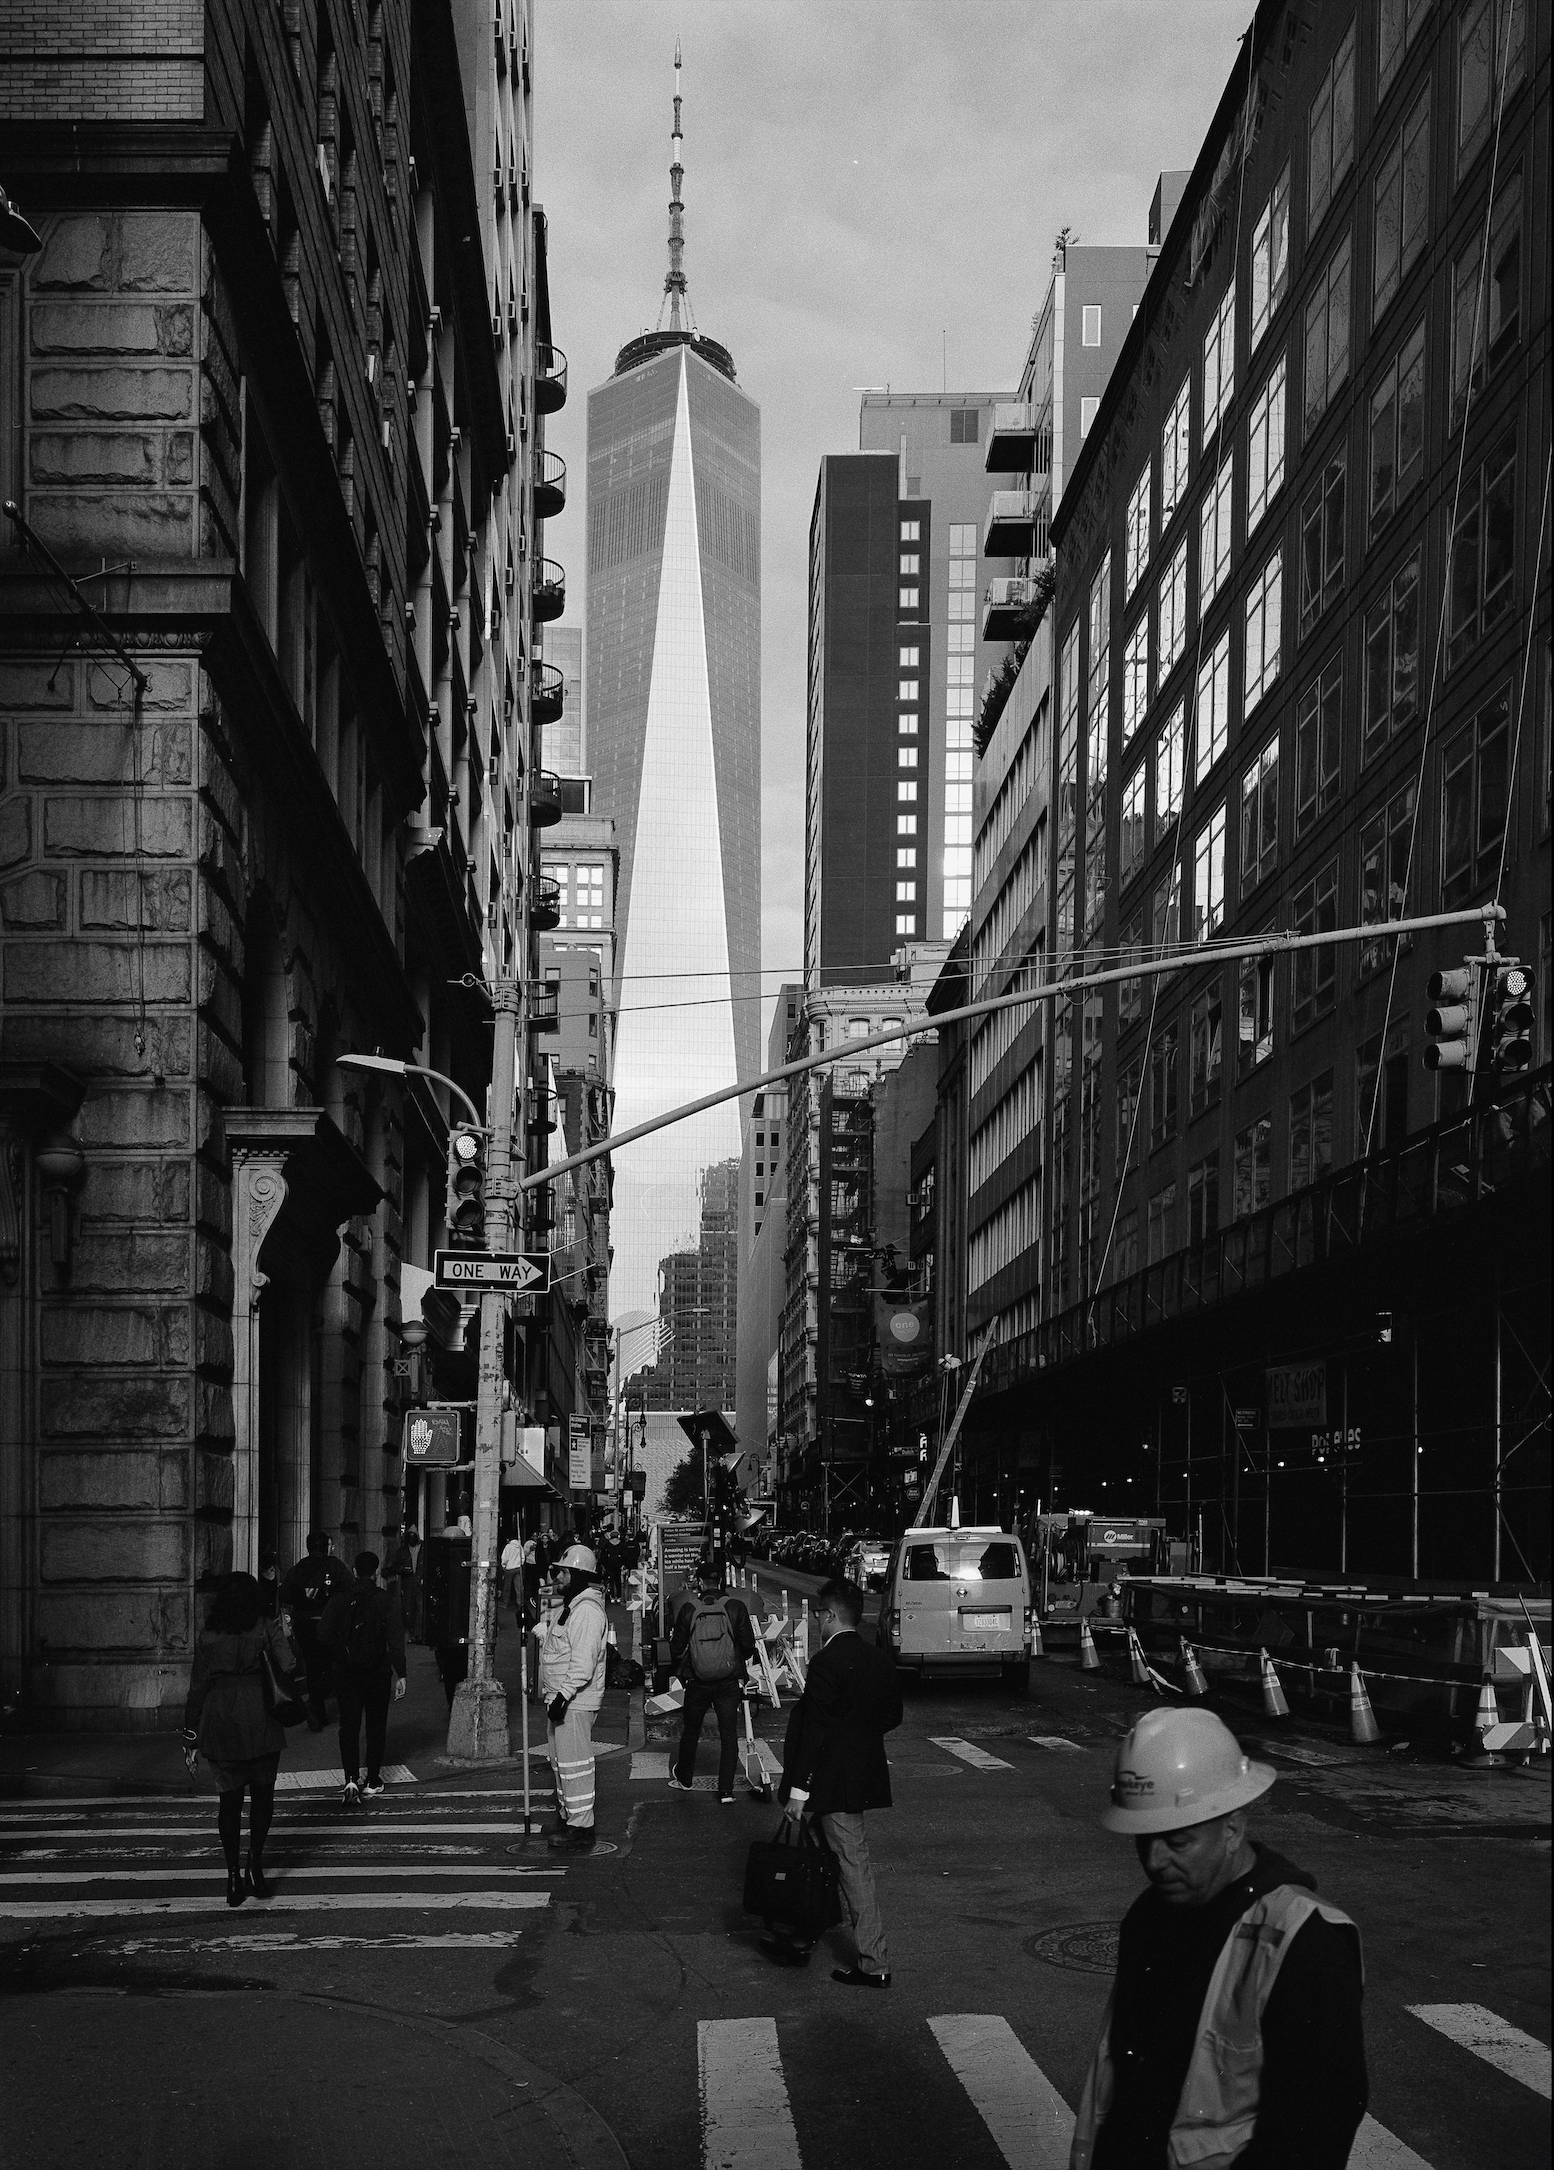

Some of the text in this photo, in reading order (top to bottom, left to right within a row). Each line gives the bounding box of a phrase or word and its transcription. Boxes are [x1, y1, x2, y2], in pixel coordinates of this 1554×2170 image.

[452, 1263, 532, 1280] ONE WAY
[895, 1321, 915, 1329] one
[1294, 1367, 1325, 1403] SHOP
